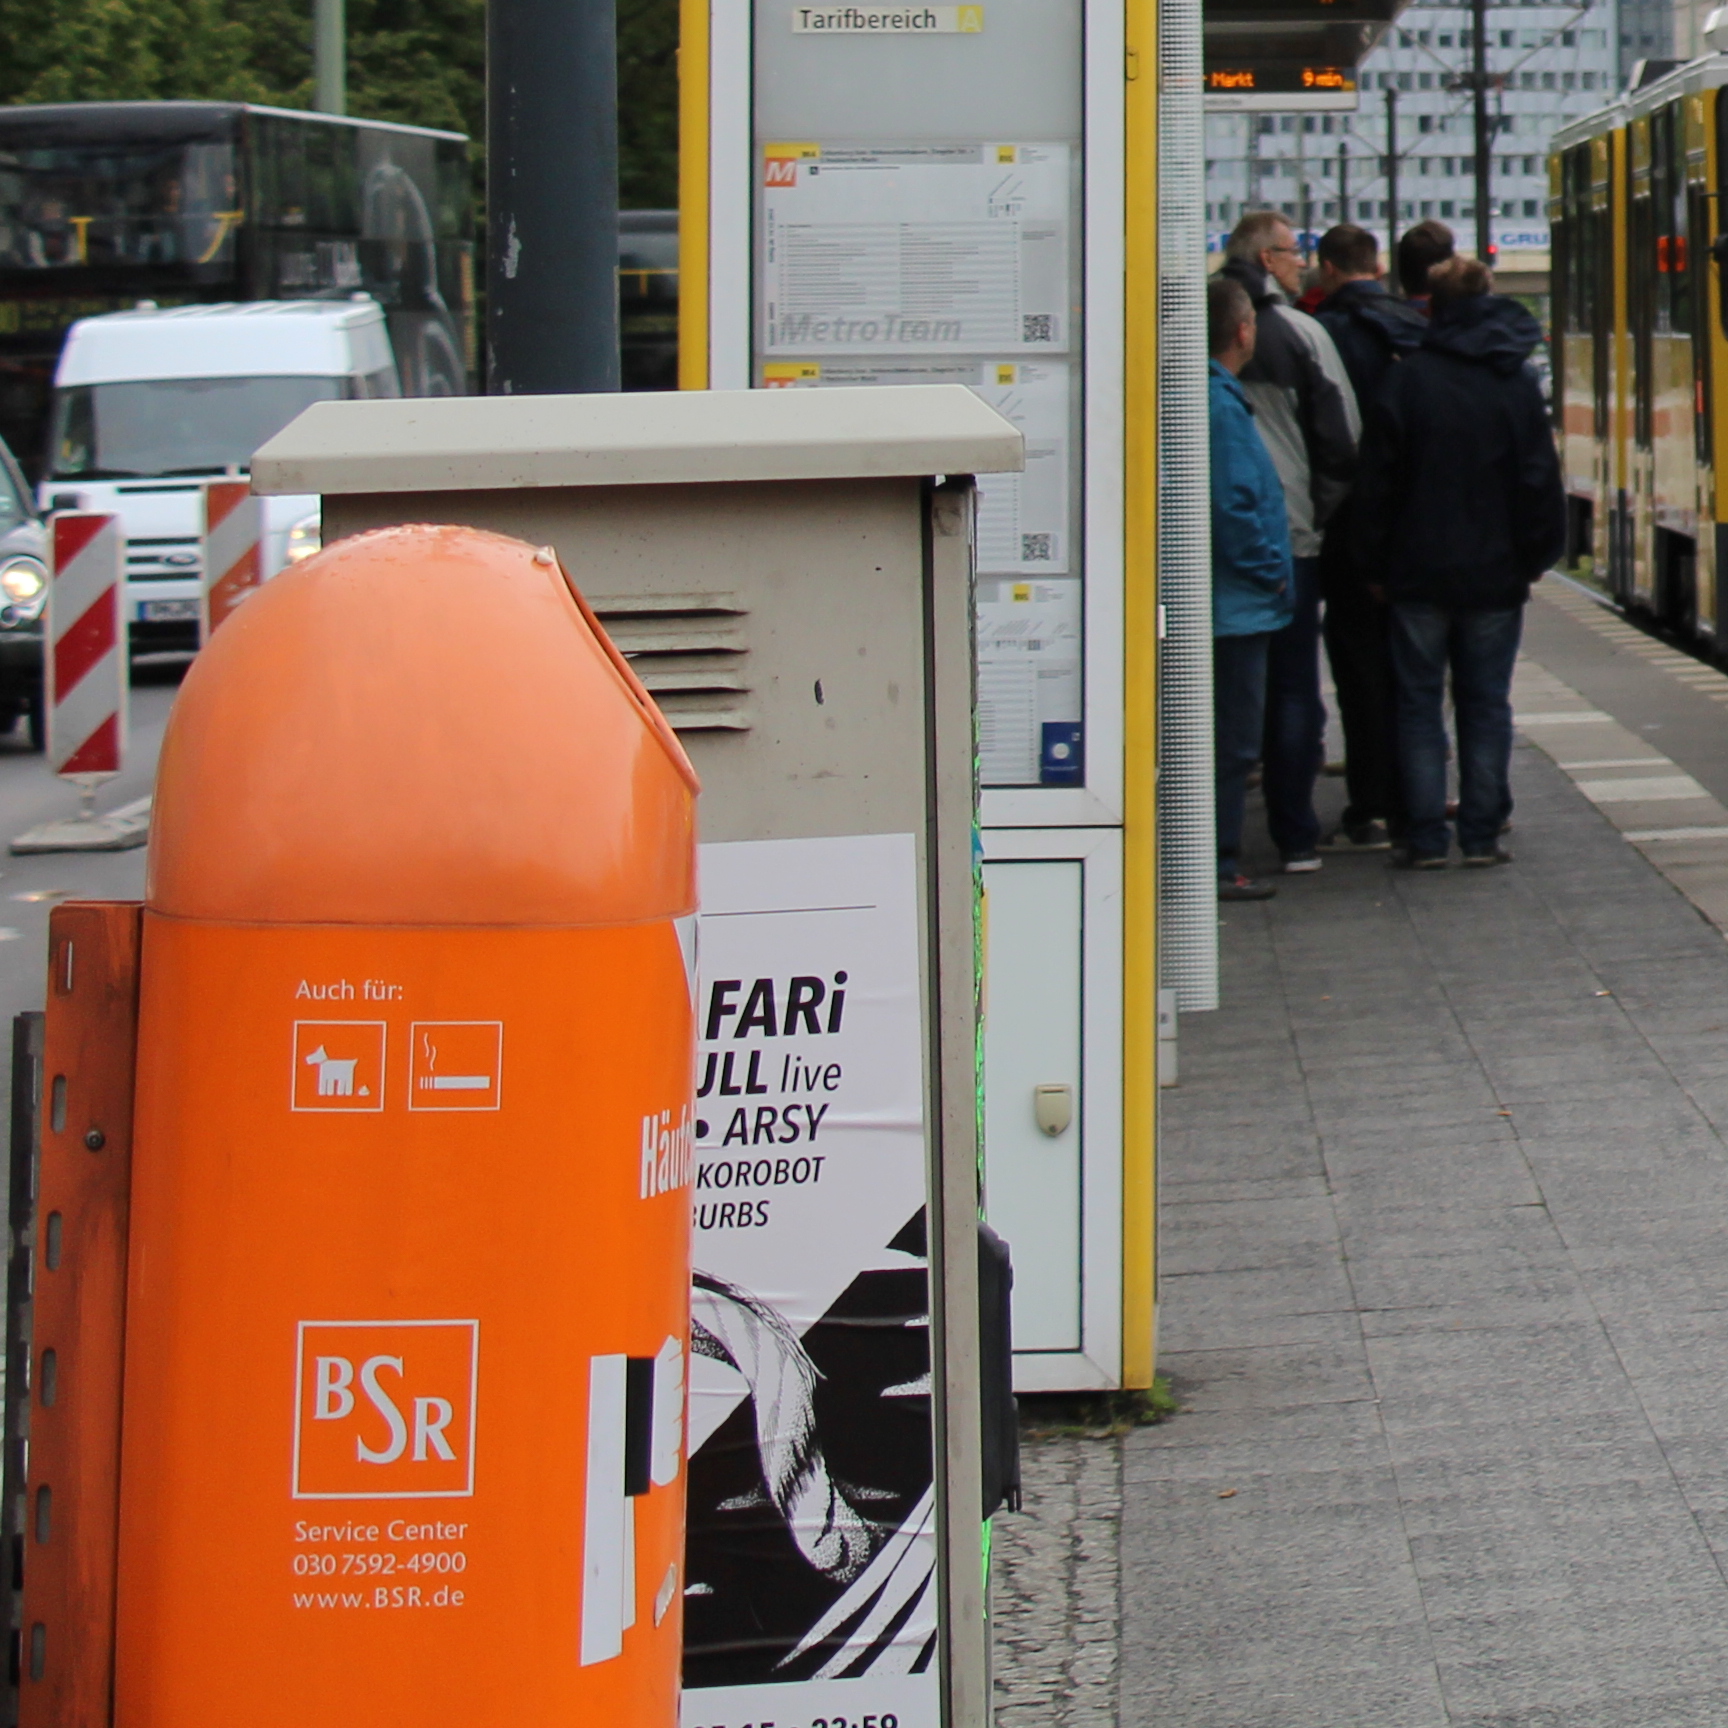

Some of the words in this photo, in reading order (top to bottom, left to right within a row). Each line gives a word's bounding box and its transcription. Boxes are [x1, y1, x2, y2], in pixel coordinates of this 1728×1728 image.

[800, 8, 937, 29] Tarifbereich
[780, 313, 961, 342] MetroTram
[295, 978, 355, 1000] Auch
[363, 979, 403, 1000] für:
[780, 1053, 842, 1093] live
[722, 1103, 830, 1147] ARSY
[314, 1355, 457, 1464] BSR
[295, 1522, 379, 1542] Service
[388, 1520, 469, 1541] Center
[293, 1554, 337, 1575] 030
[341, 1552, 467, 1575] 7592-4900
[293, 1586, 465, 1608] www.BSR.de
